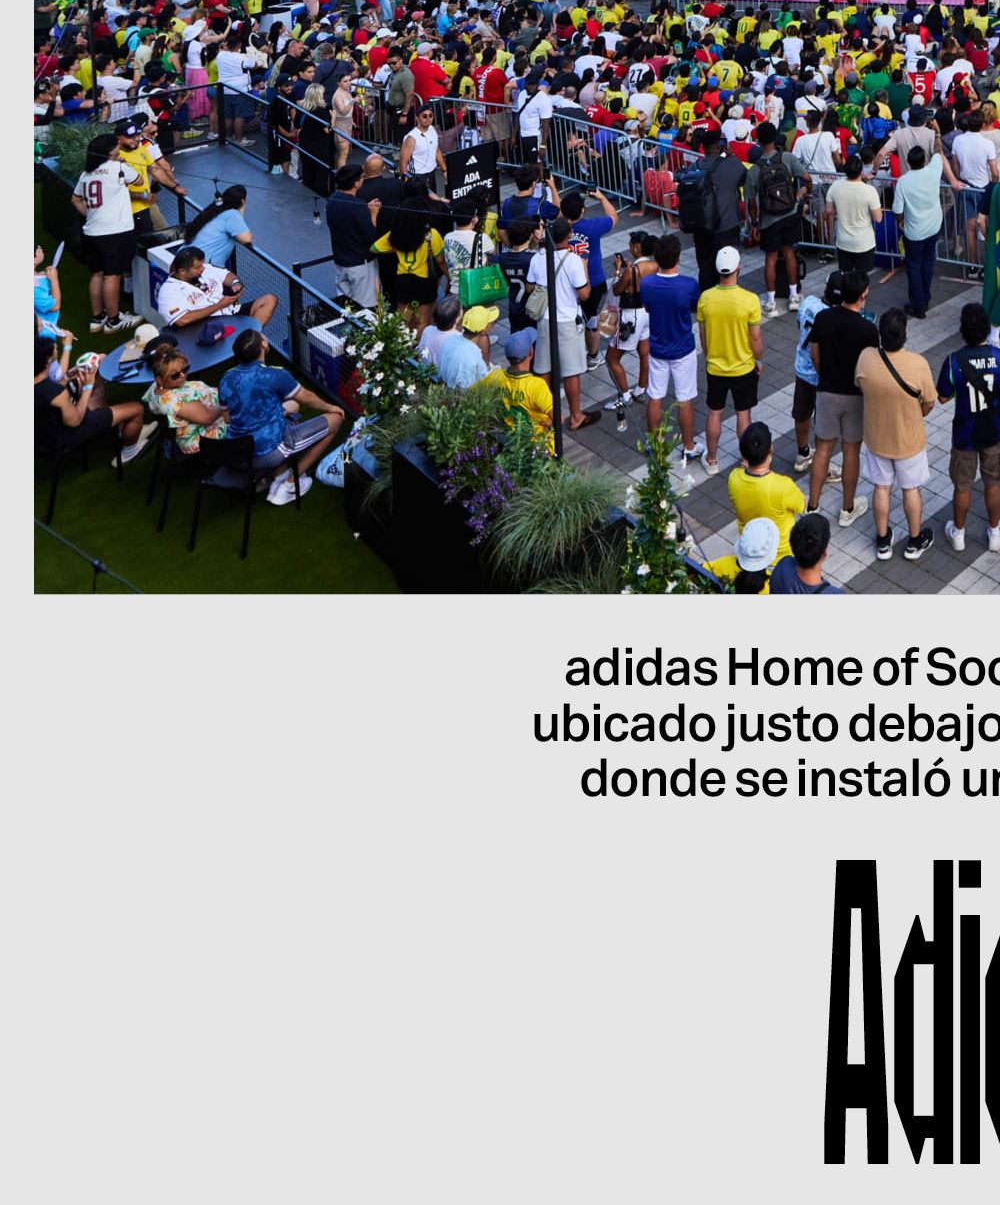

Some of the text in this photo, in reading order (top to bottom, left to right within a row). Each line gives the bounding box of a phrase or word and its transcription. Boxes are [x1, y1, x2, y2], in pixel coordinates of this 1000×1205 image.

[629, 69, 642, 84] 27
[722, 68, 730, 83] 7
[914, 77, 926, 93] 5
[464, 171, 480, 184] ADA
[510, 278, 526, 304] 7
